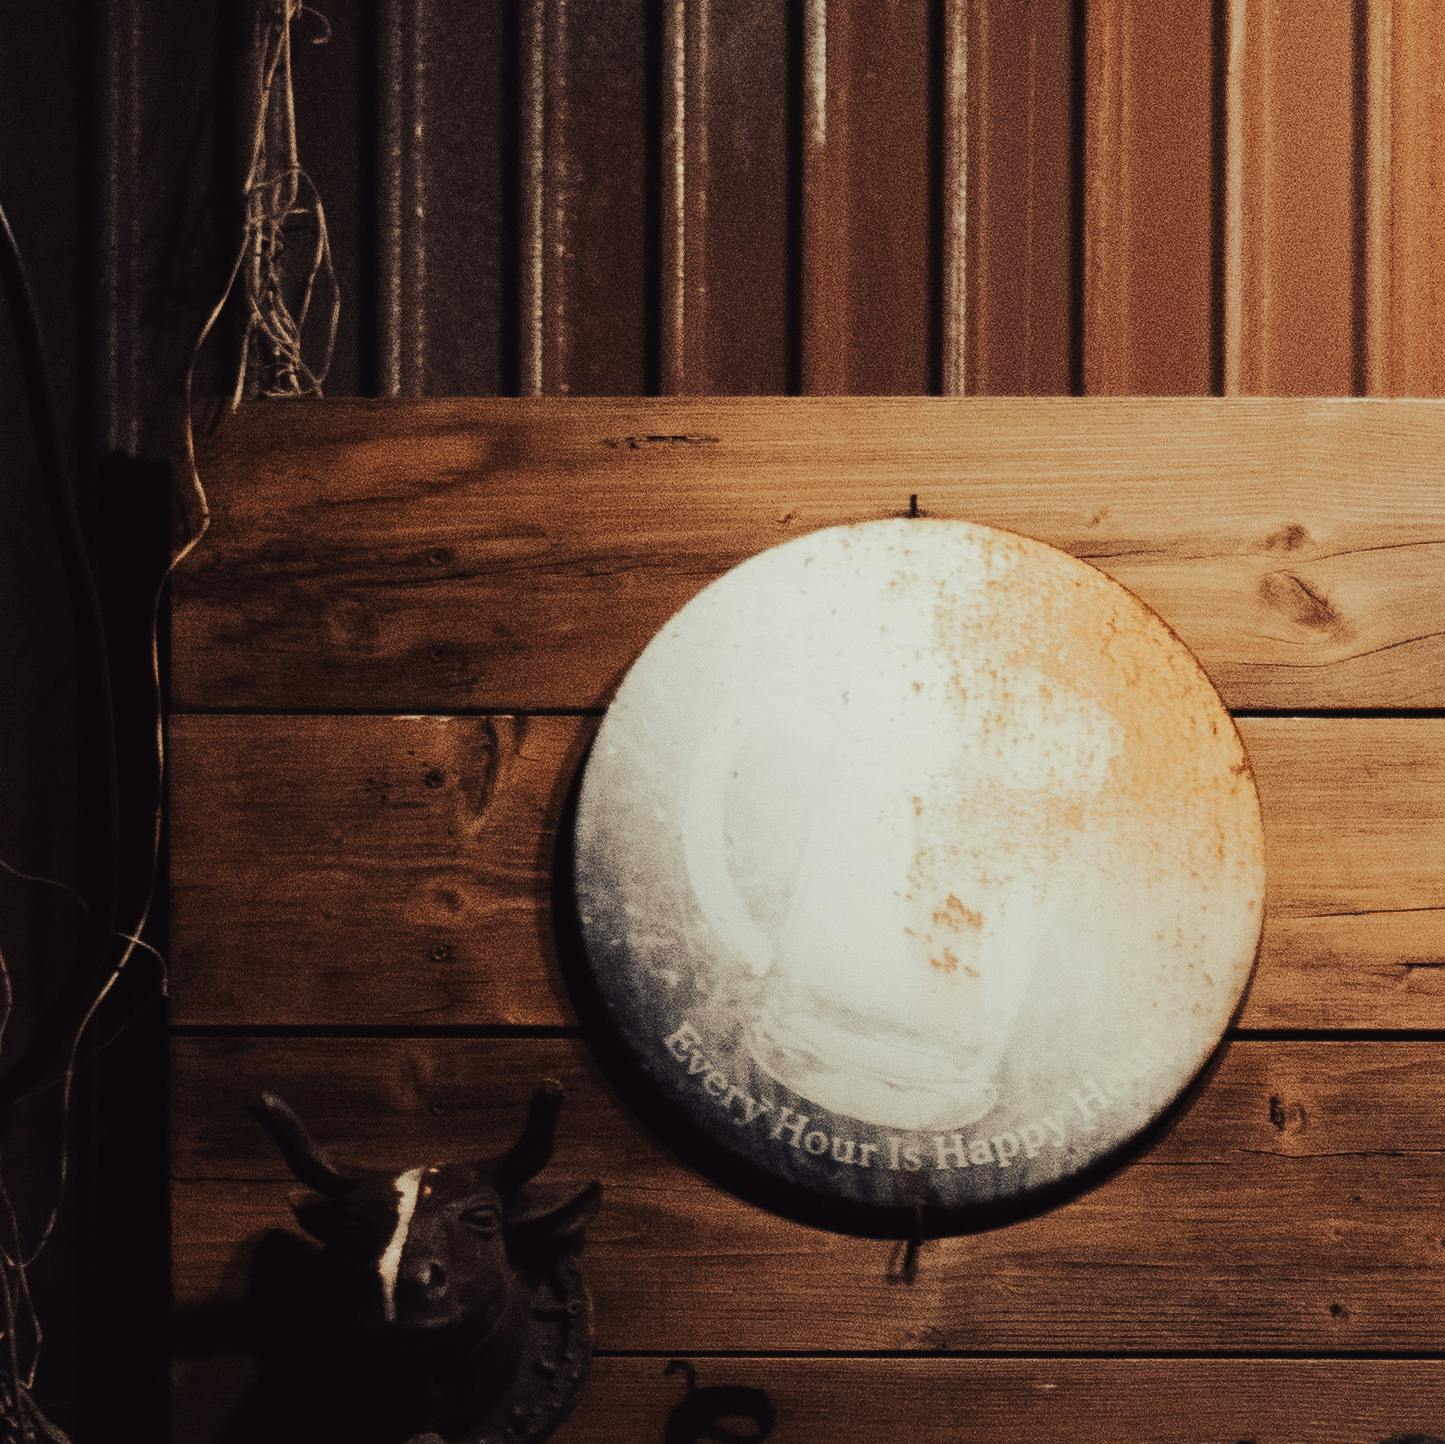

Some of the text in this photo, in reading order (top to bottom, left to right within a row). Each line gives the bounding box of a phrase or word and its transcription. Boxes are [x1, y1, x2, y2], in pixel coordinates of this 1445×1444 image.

[660, 1021, 769, 1126] Every
[770, 1106, 880, 1169] Hour
[887, 1136, 925, 1172] Is
[933, 1108, 1072, 1170] Happy
